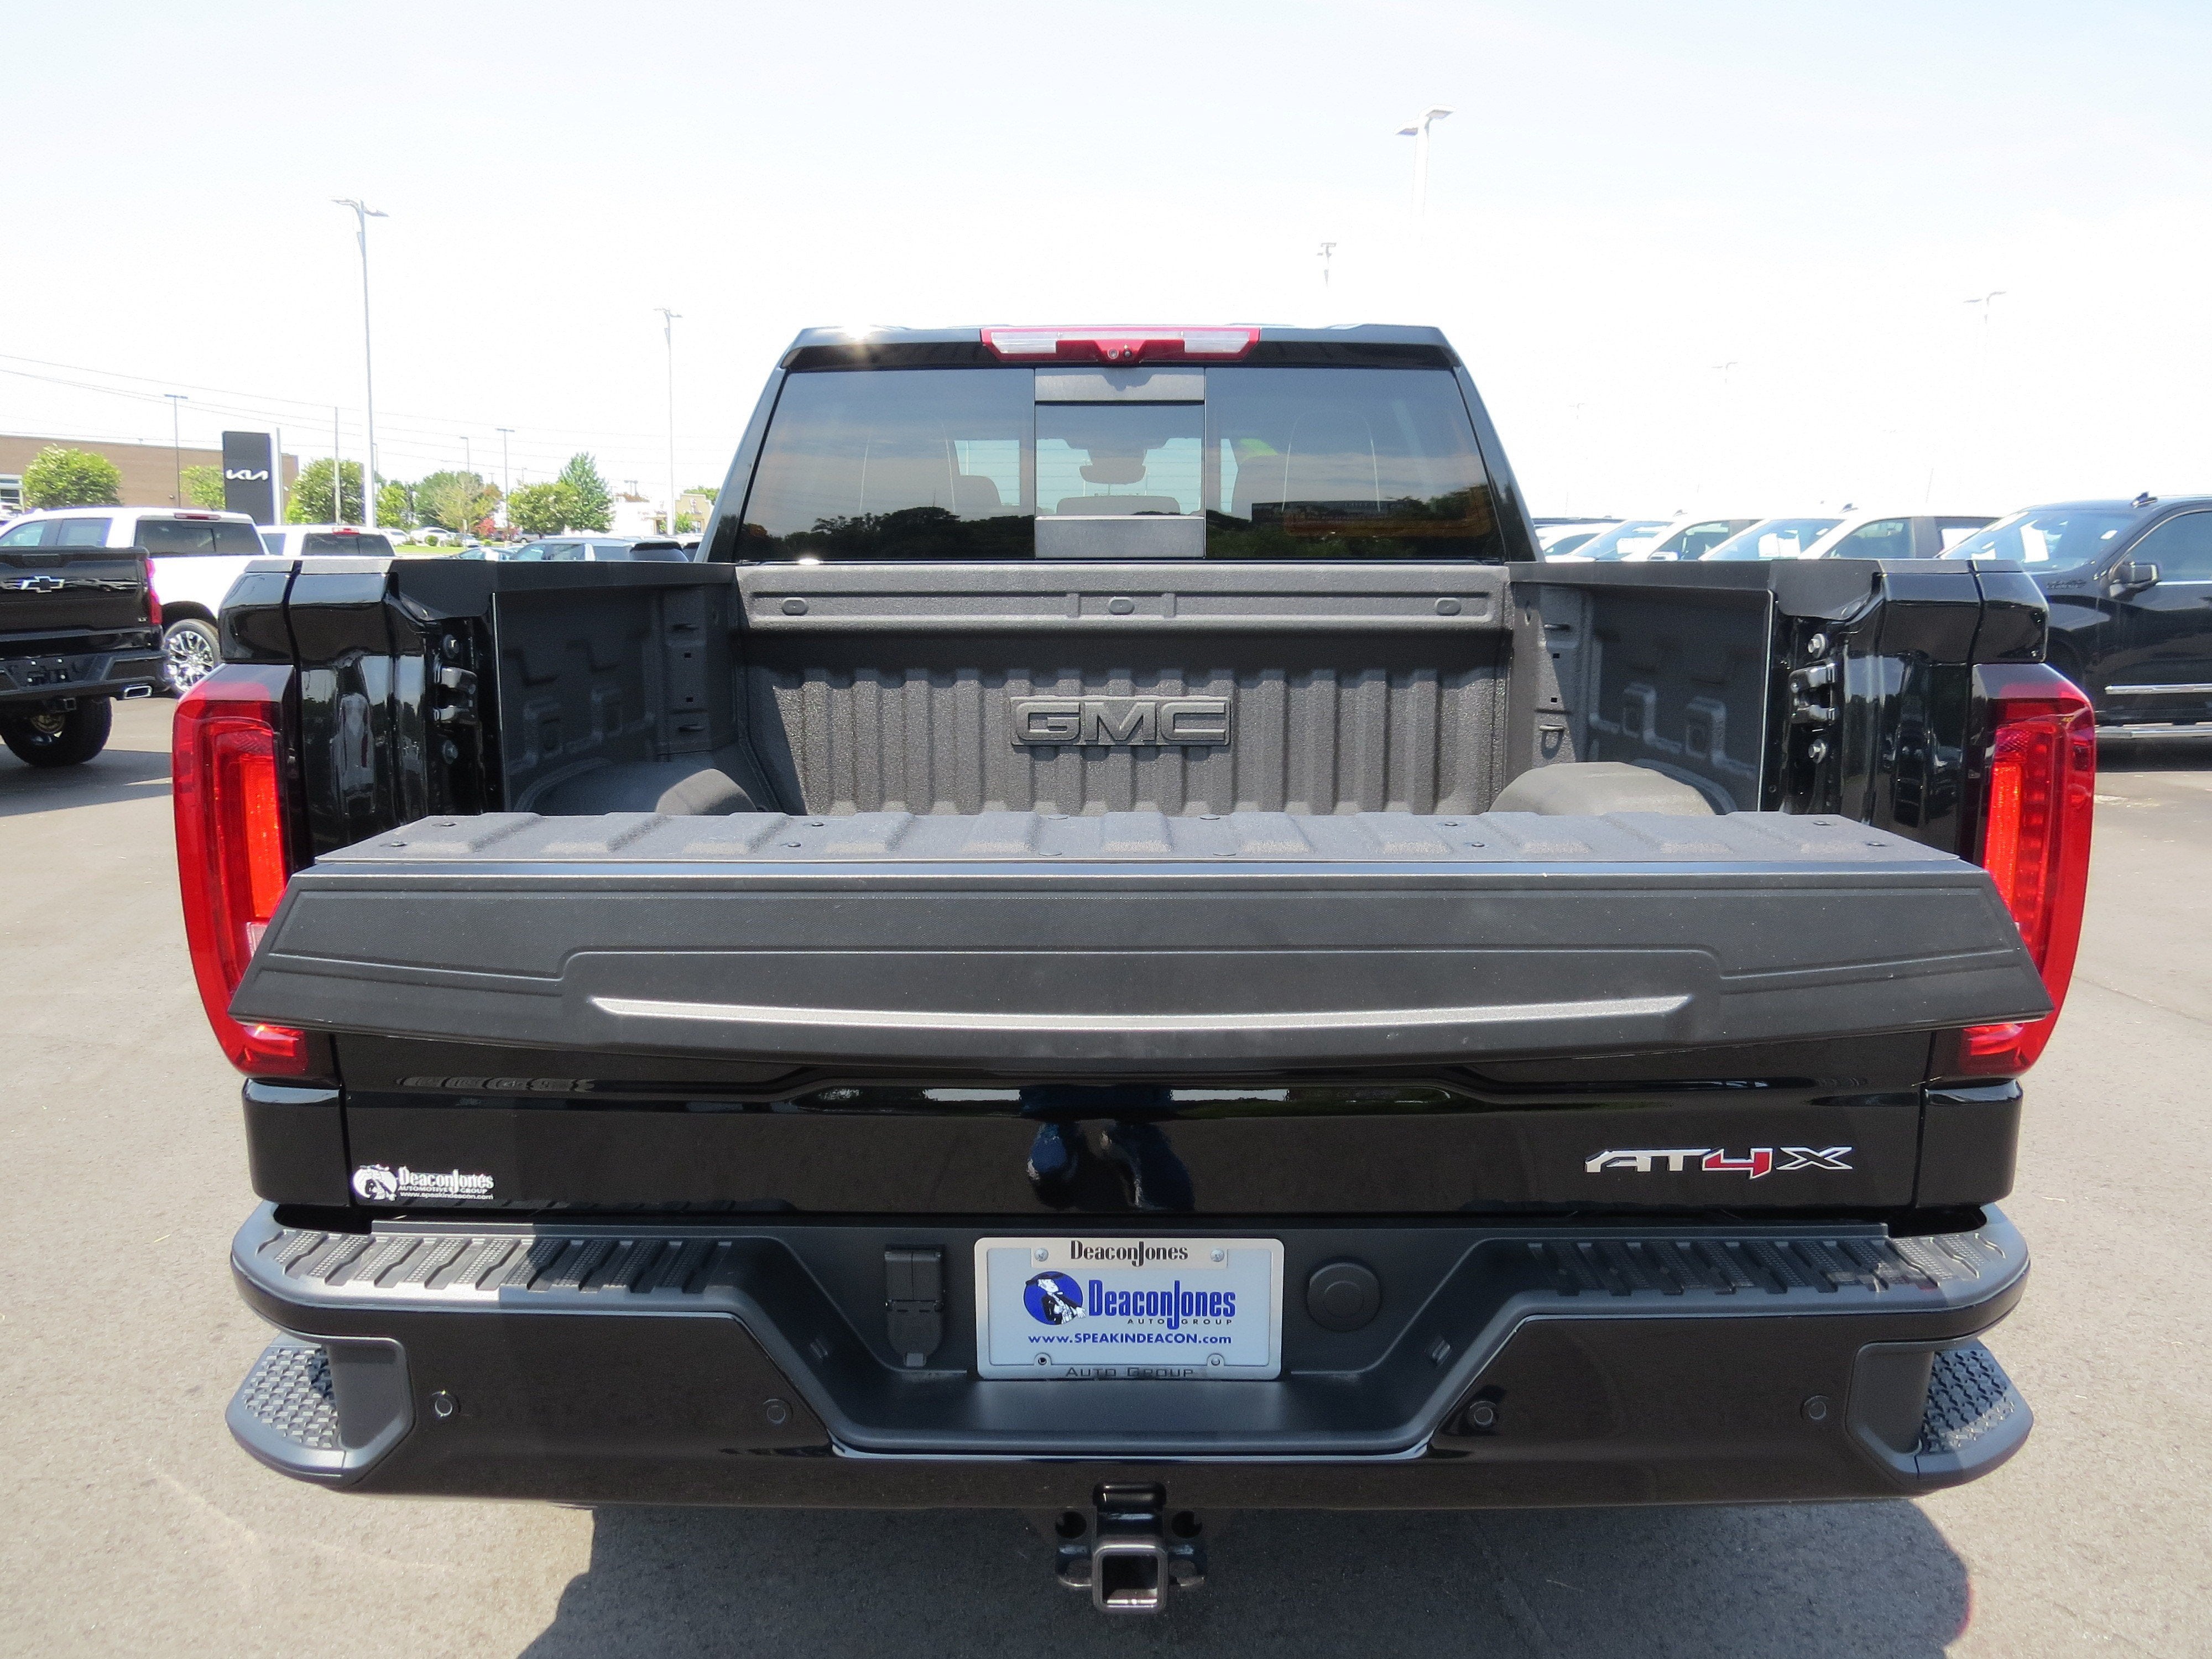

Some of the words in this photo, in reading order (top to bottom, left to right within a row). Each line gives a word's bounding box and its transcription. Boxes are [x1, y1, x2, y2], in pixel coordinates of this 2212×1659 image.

[1015, 701, 1227, 743] GMC
[1585, 1146, 1853, 1180] AT4X
[400, 1192, 494, 1200] www.speakindeacon.com
[1028, 1332, 1232, 1344] www.SPEAKINDEACON.com
